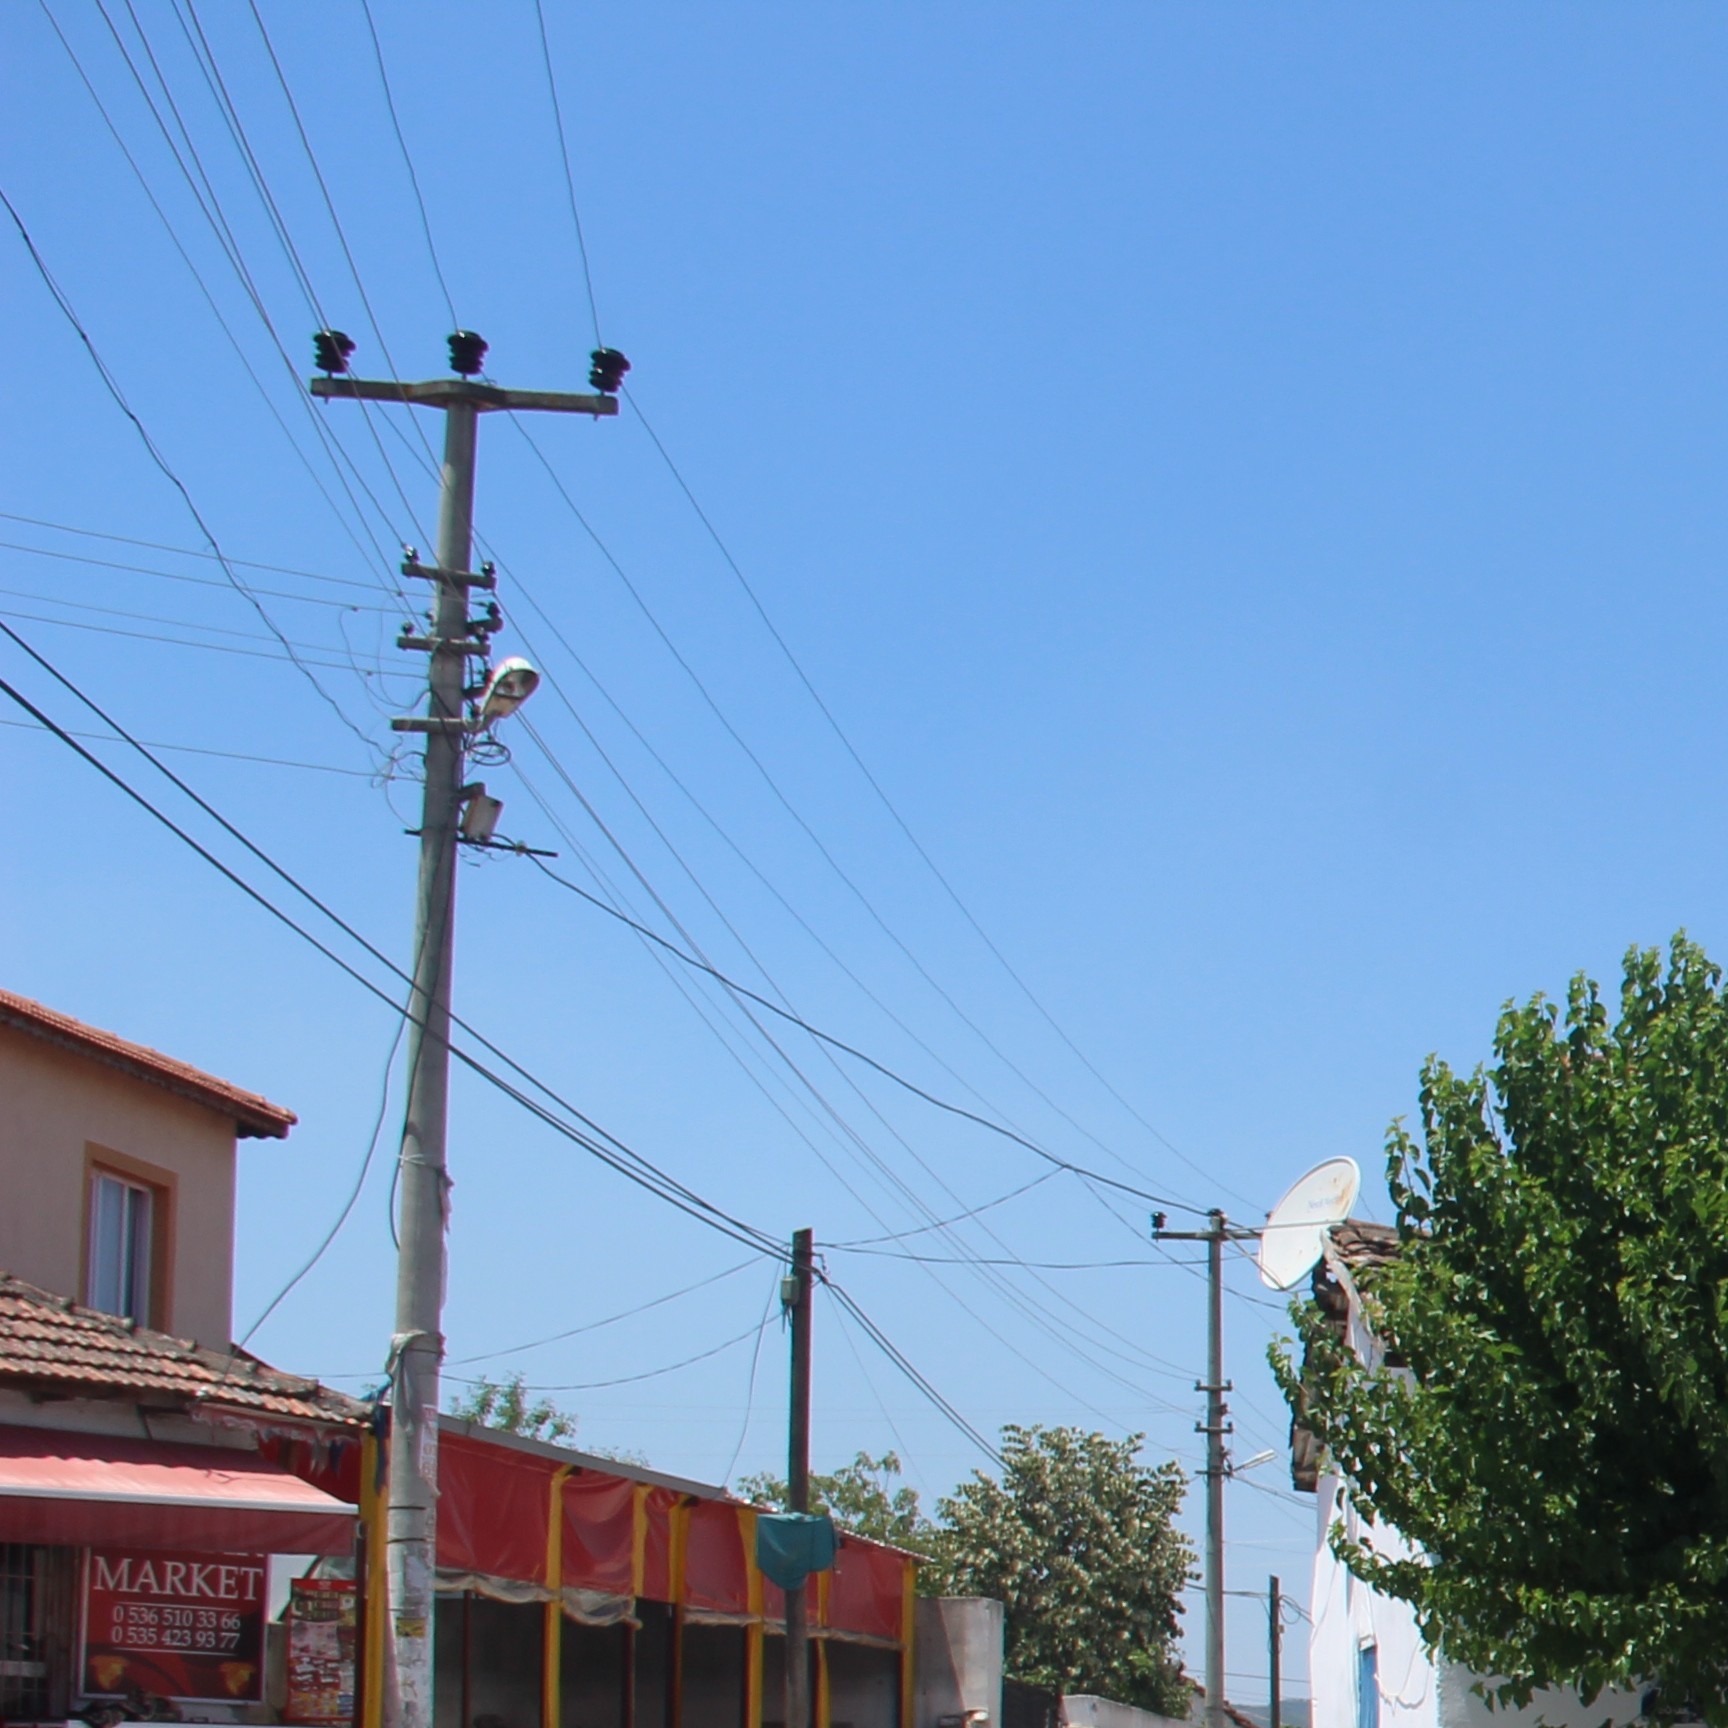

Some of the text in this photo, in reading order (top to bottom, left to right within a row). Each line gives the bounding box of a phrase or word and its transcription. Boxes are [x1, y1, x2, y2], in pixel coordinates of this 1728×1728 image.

[93, 1555, 264, 1601] MARKET
[112, 1605, 241, 1630] 0 536 510 33 66
[111, 1626, 241, 1648] 0 535 423 93 77
